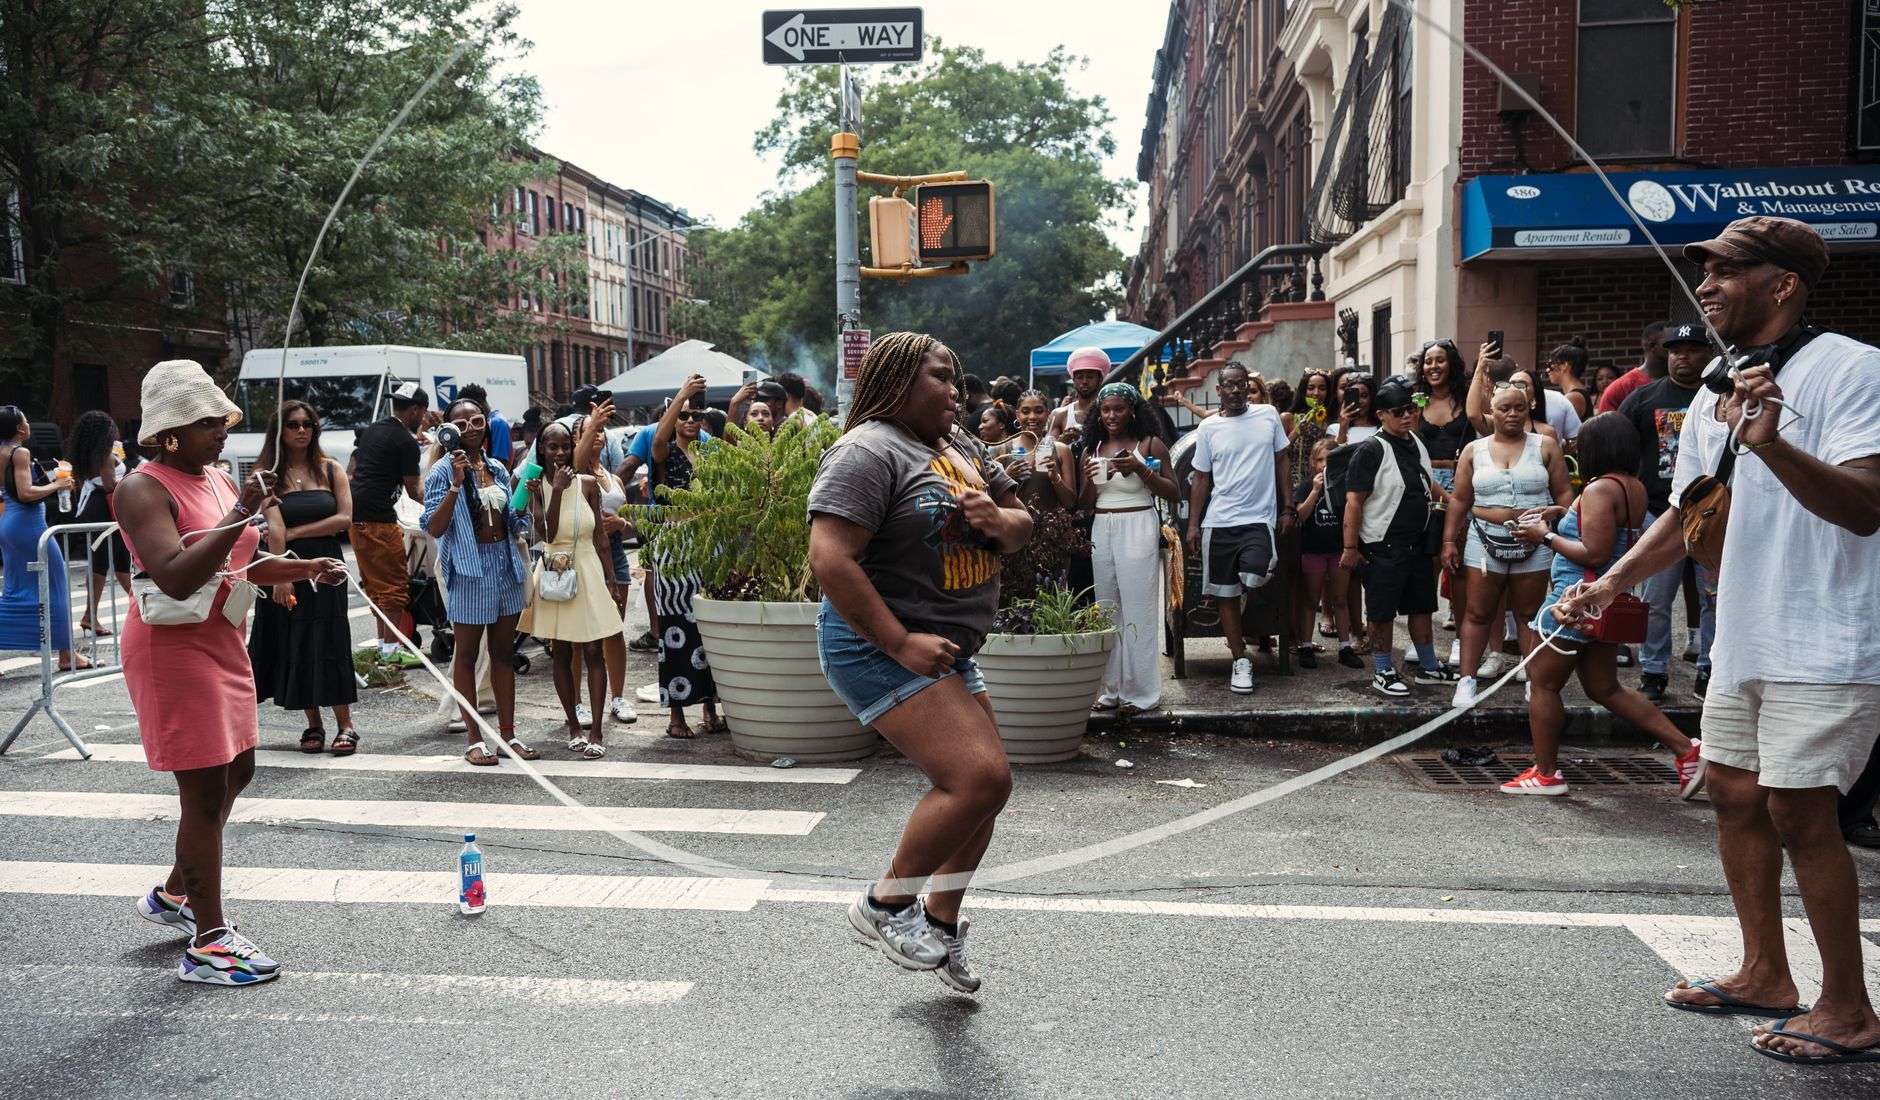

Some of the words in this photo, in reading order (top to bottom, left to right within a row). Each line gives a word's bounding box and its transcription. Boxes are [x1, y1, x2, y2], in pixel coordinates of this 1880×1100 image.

[784, 26, 830, 48] ONE
[857, 24, 908, 46] WAY
[1512, 186, 1536, 198] 386
[1666, 180, 1837, 213] Wallabout
[1736, 201, 1758, 215] &
[1814, 226, 1837, 236] use
[1838, 223, 1869, 235] Sales
[1524, 233, 1579, 245] Apartment
[1582, 230, 1623, 242] Rentals
[1678, 325, 1692, 337] NY
[464, 862, 481, 877] FIJI
